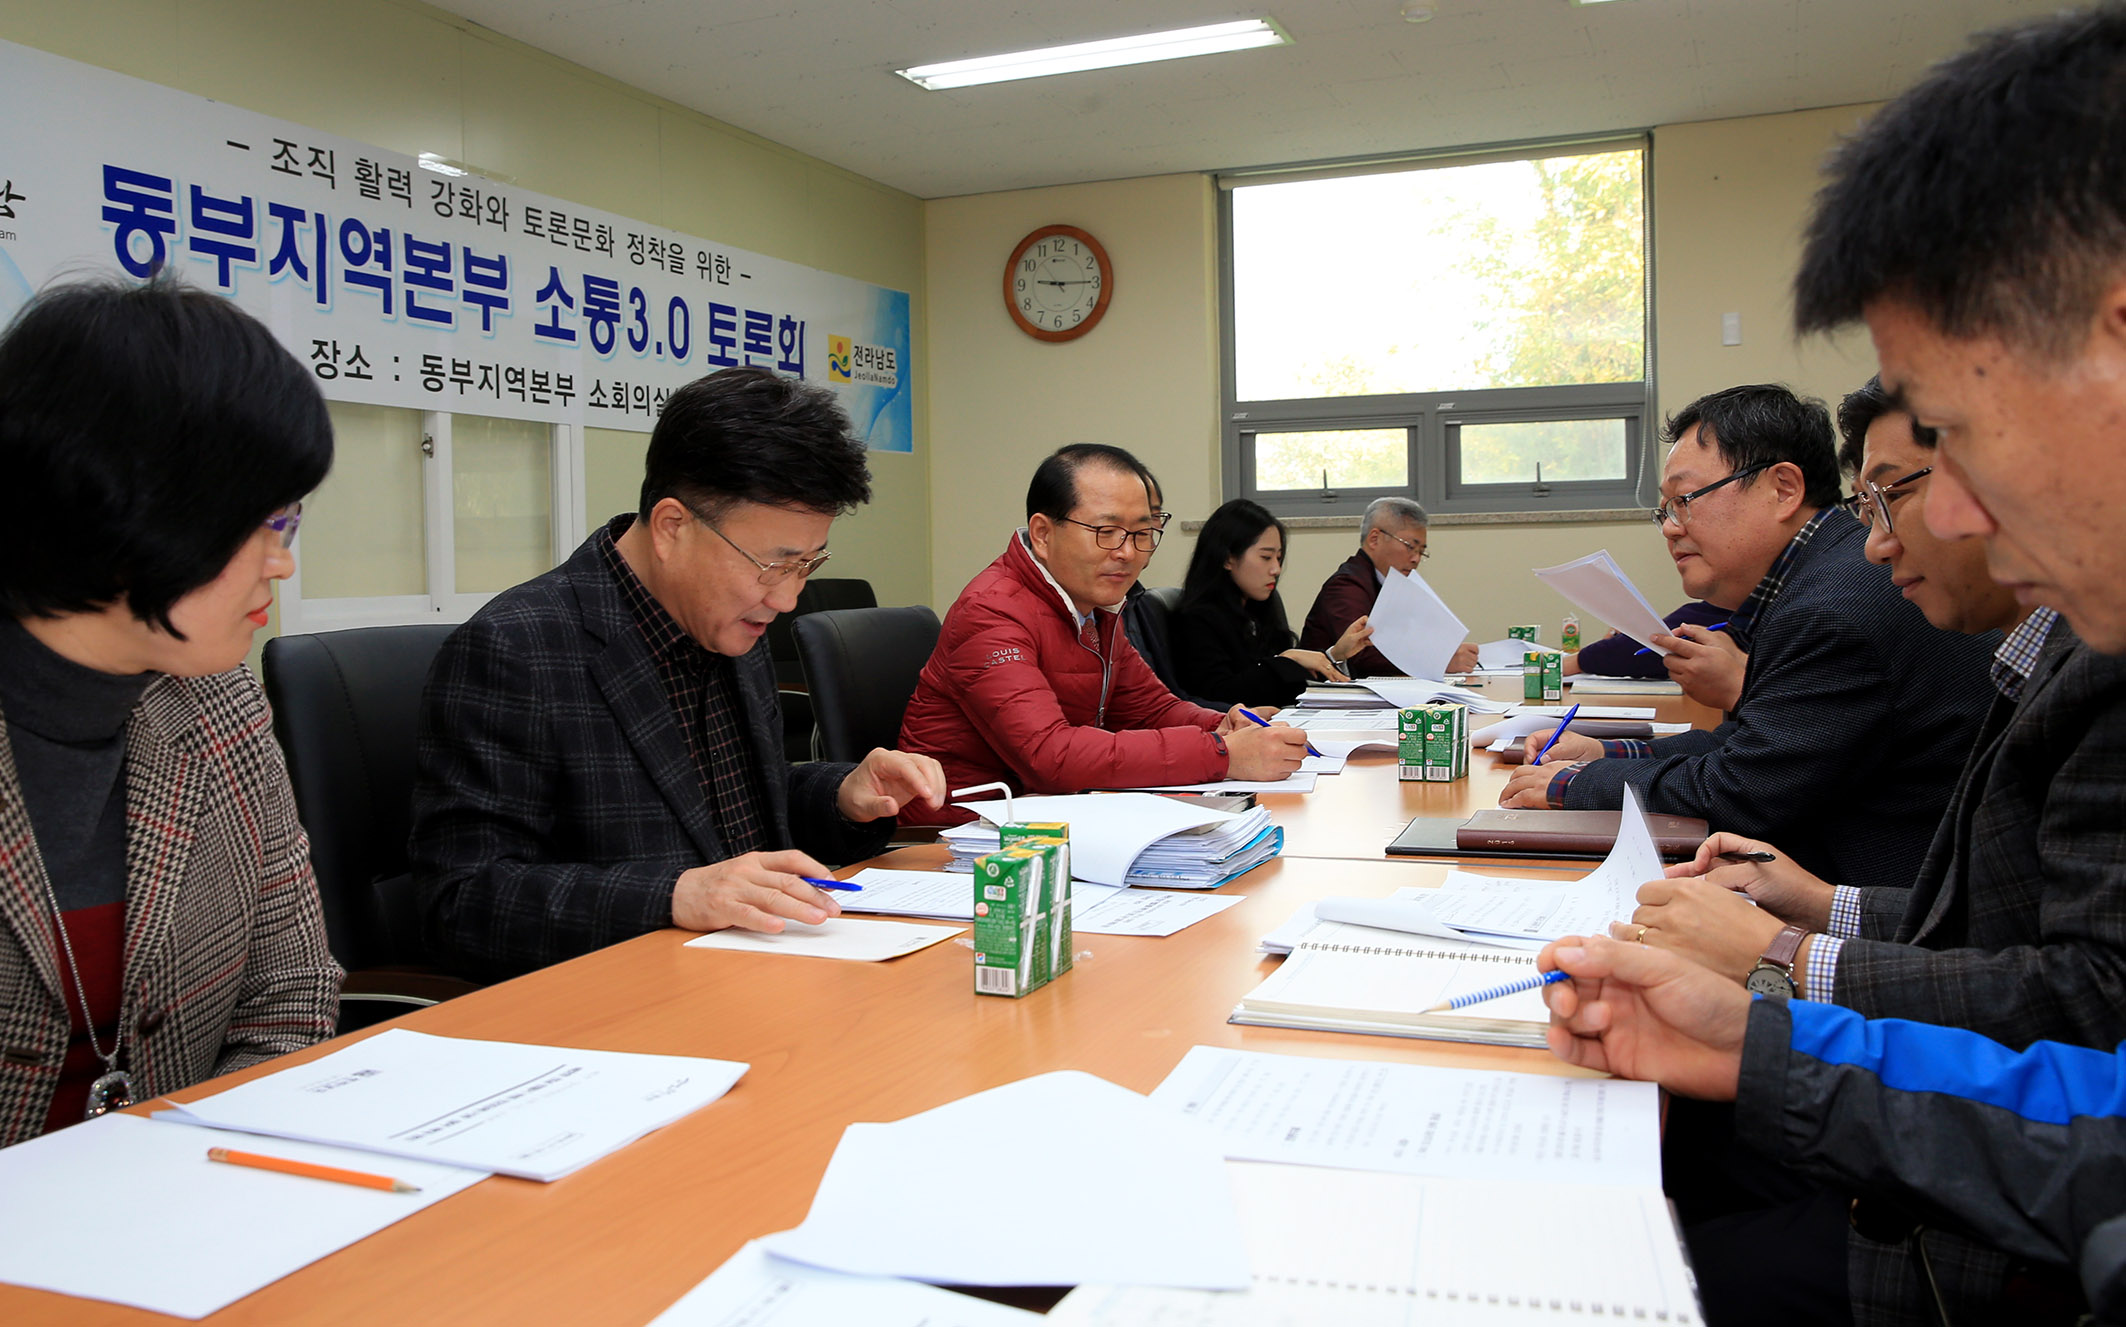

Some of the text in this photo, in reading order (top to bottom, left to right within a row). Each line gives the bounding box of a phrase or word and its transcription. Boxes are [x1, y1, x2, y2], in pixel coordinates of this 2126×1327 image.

[271, 138, 335, 190] 조직
[354, 158, 412, 208] 활력
[431, 180, 509, 232] 강화와
[523, 206, 615, 258] 토론문화
[627, 232, 685, 275] 정착을
[696, 251, 731, 286] 위한
[1038, 245, 1047, 257] 11
[1053, 239, 1065, 252] 12
[1073, 243, 1078, 255] 1
[1024, 259, 1036, 272] 10
[1086, 256, 1094, 269] 2
[102, 164, 805, 381] 동부지역본부 소통3.0 토론회
[1017, 279, 1026, 292] 9
[1092, 276, 1100, 289] 3
[1024, 298, 1032, 310] 8
[1086, 296, 1093, 308] 4
[1037, 311, 1045, 323] 7
[1054, 315, 1062, 328] 6
[1072, 309, 1081, 322] 5
[853, 345, 895, 370] 전라남도
[310, 339, 373, 380] 장소
[420, 354, 576, 407] 동부지역본부
